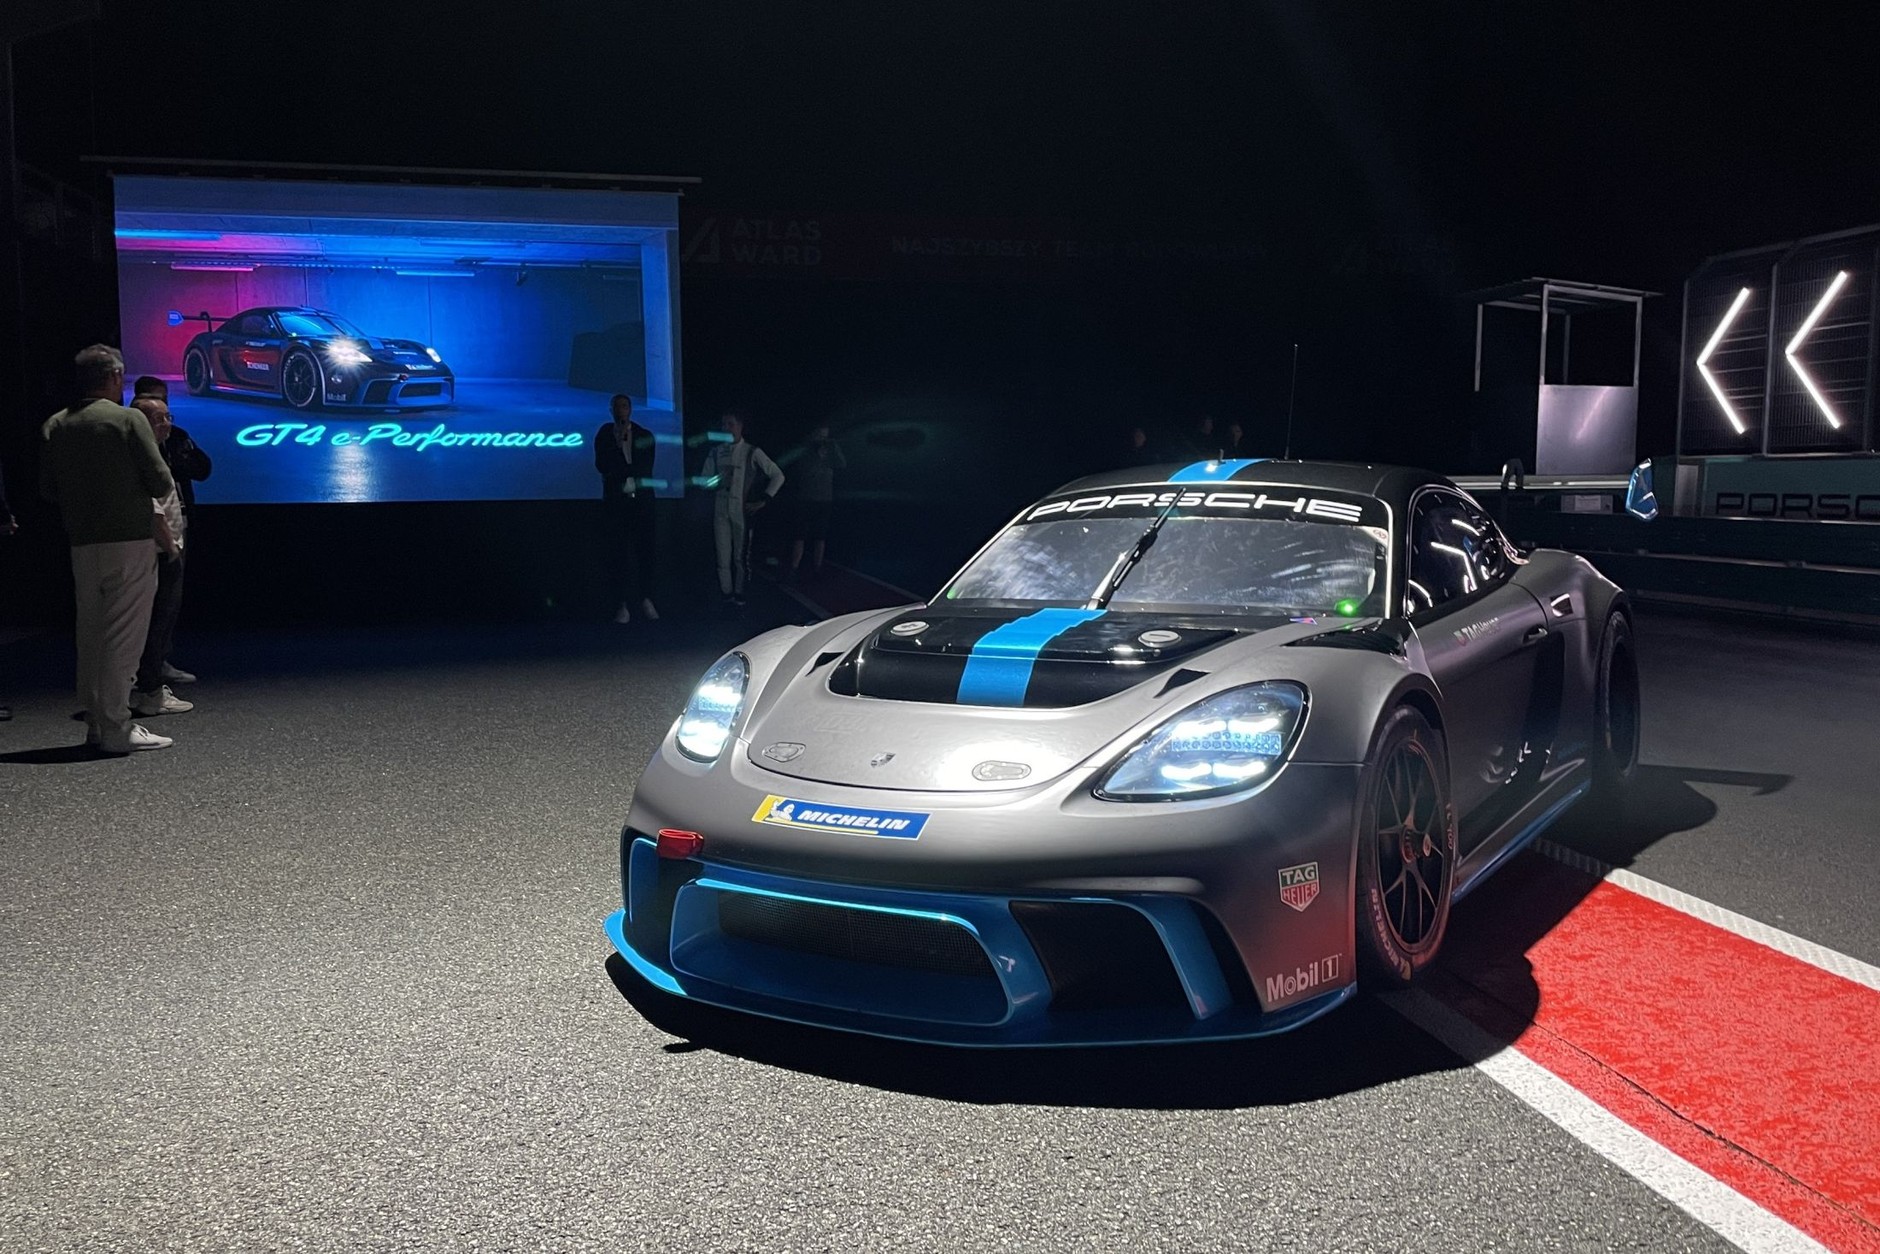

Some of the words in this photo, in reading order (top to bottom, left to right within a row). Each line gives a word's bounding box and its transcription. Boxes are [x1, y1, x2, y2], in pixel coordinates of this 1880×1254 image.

[732, 219, 821, 240] ATLAS
[732, 245, 821, 265] WARD
[236, 424, 326, 446] GT4
[331, 423, 583, 452] e-Performance
[1027, 492, 1363, 523] PORSCHE
[797, 810, 911, 830] MICHELIN
[1282, 866, 1315, 885] TAG
[1282, 883, 1317, 906] HEUER
[1266, 961, 1319, 1002] Mobil
